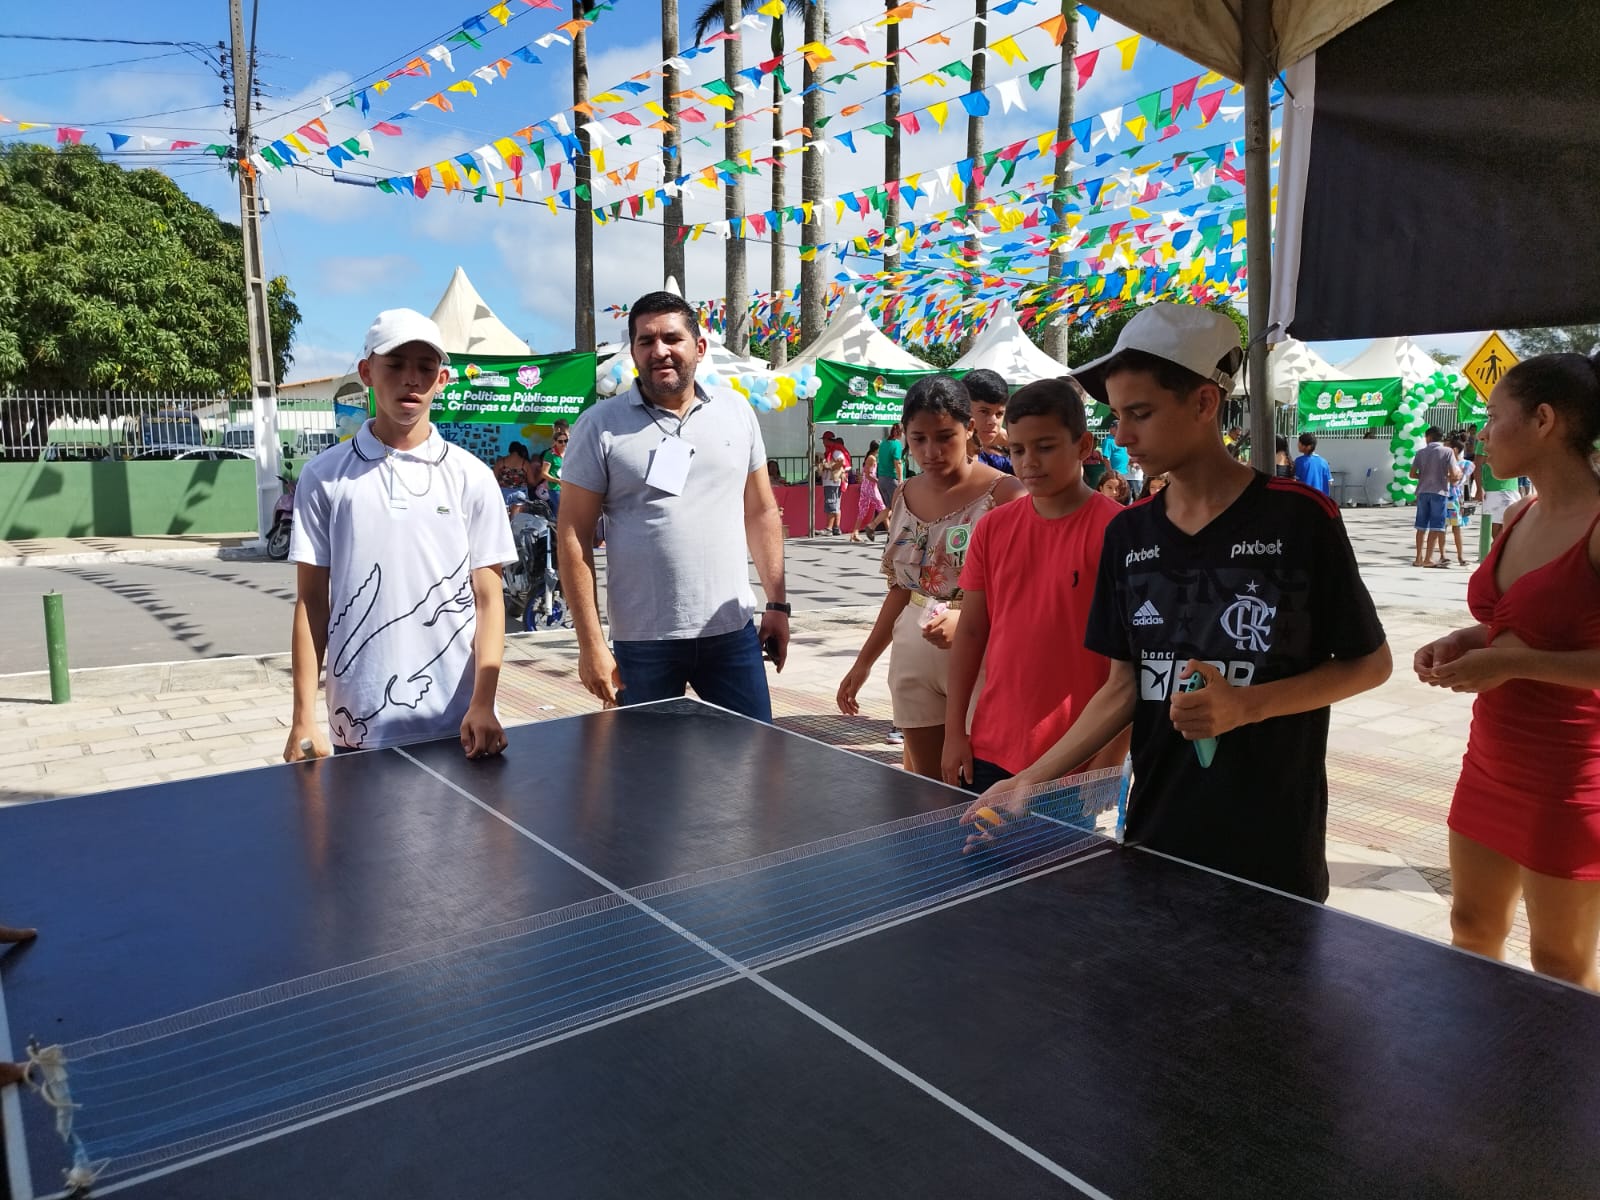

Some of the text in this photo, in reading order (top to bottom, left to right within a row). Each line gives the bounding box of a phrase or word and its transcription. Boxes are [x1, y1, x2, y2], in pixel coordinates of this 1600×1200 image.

[447, 389, 462, 400] de
[463, 390, 511, 401] Políticas
[513, 392, 559, 403] Públicas
[559, 395, 585, 406] para
[448, 400, 499, 413] Crianças
[501, 404, 508, 412] e
[509, 402, 580, 413] Adolescentes
[875, 402, 886, 410] de
[1231, 539, 1283, 559] pixbet
[1125, 545, 1161, 568] pixbet
[1132, 615, 1164, 626] adidas
[1141, 649, 1174, 660] banc
